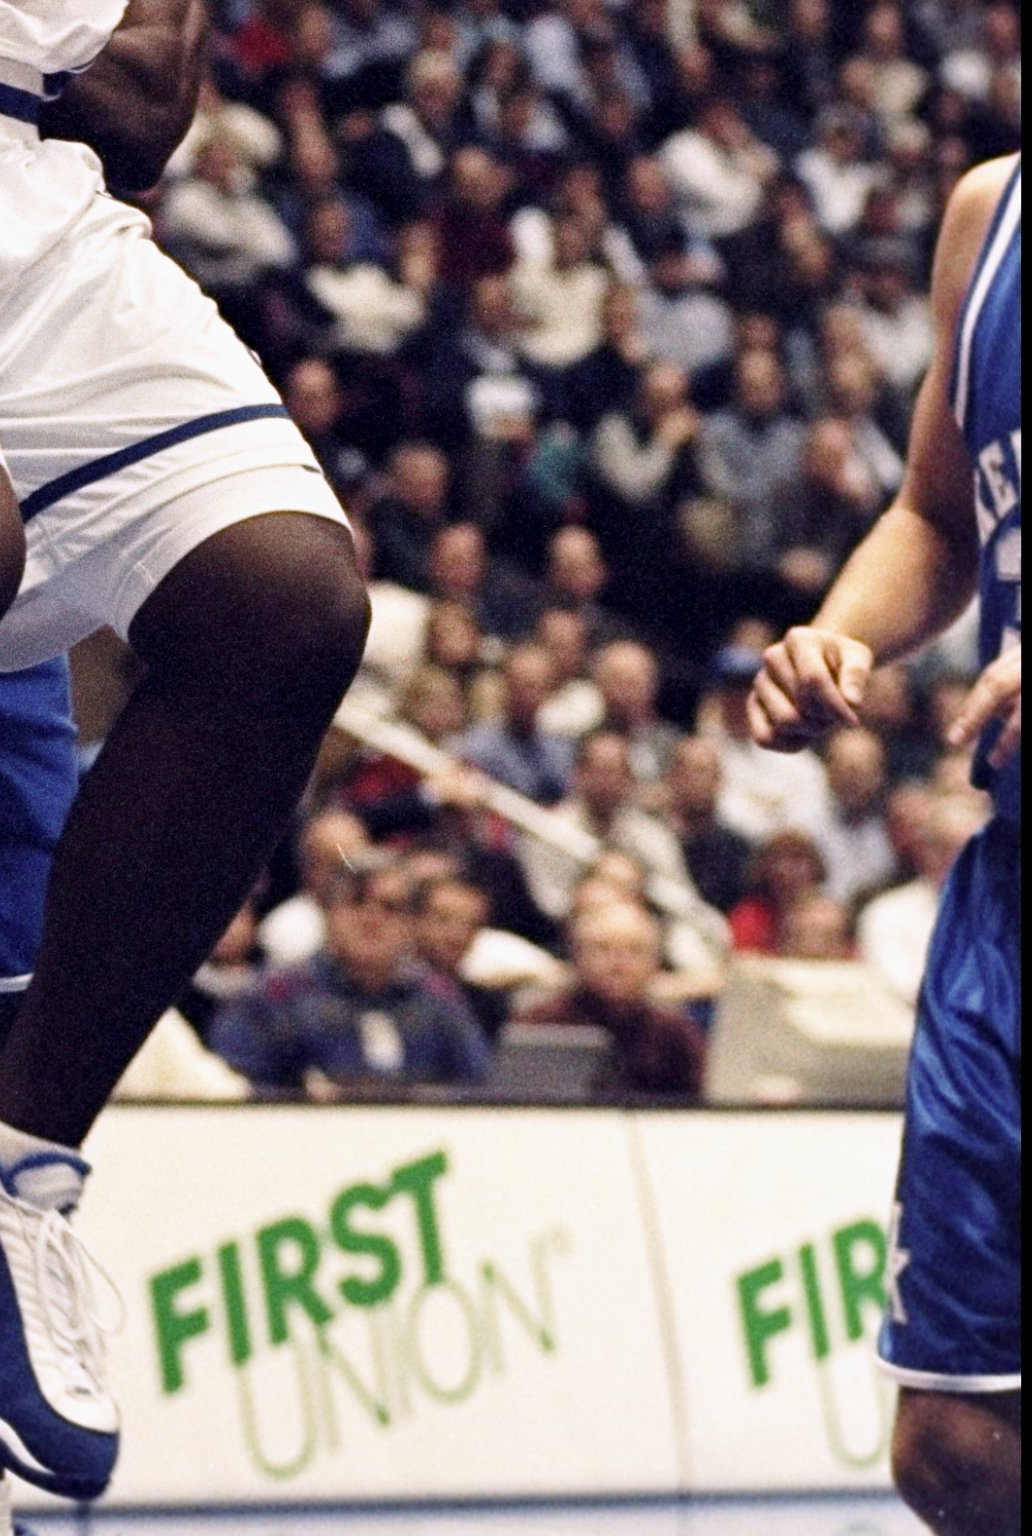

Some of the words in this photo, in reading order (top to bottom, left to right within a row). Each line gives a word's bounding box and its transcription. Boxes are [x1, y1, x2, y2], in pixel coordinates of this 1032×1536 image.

[149, 1149, 449, 1395] FIRST
[236, 1234, 556, 1480] UNION
[736, 1218, 889, 1386] FIR
